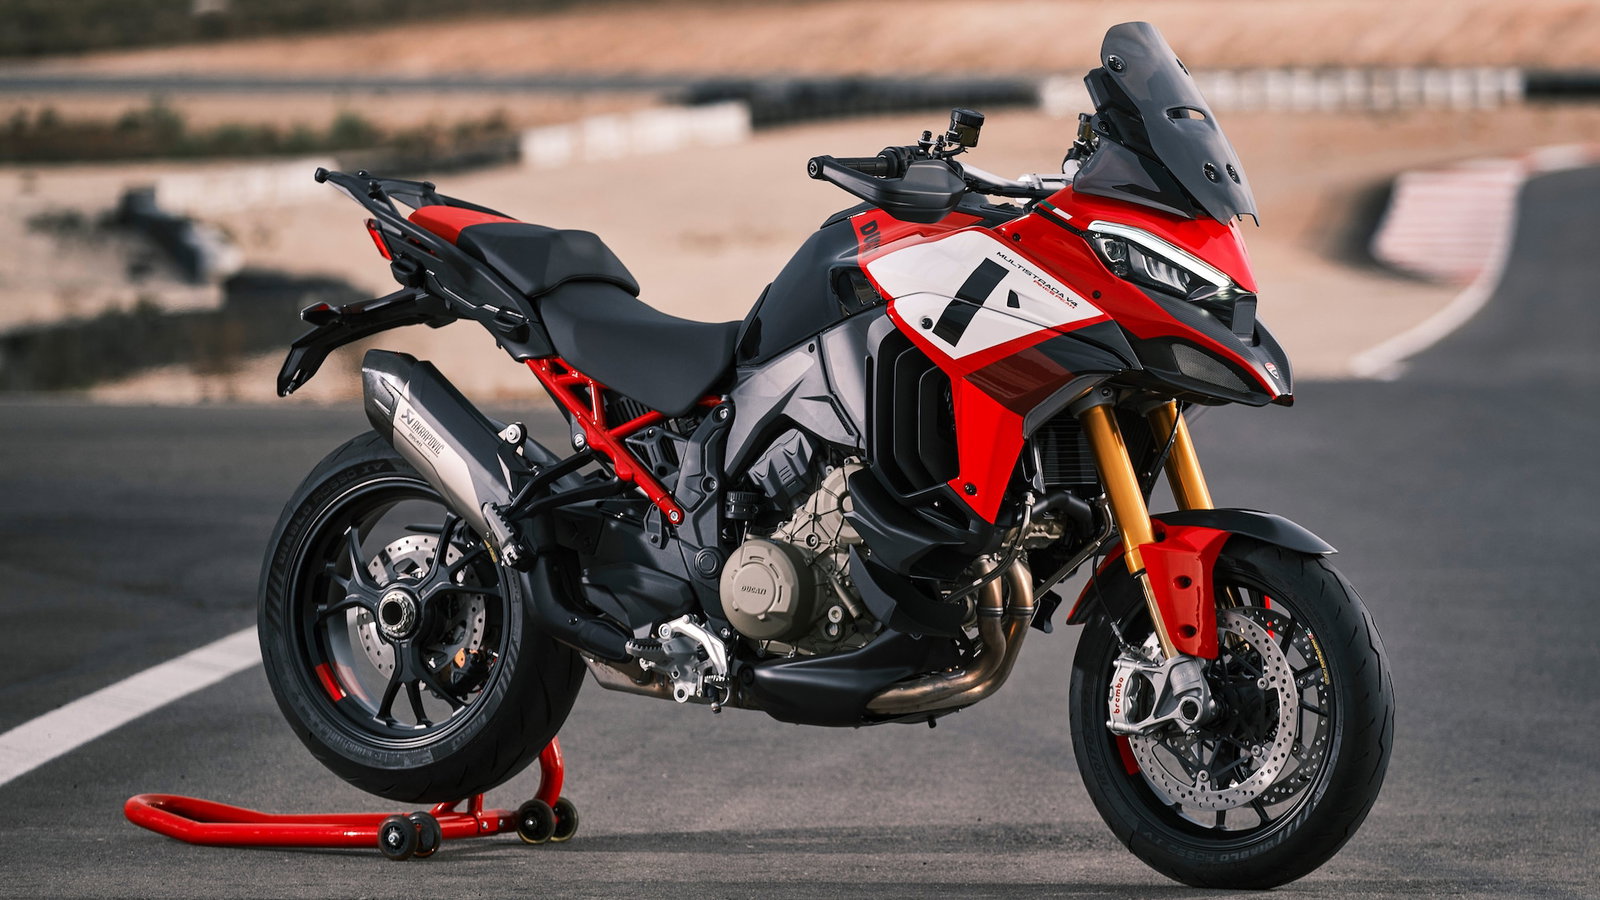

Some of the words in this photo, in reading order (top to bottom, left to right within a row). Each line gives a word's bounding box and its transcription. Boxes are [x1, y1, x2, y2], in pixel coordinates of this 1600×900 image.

[996, 251, 1065, 298] MULTISTRADA
[1066, 296, 1078, 307] V4
[741, 585, 767, 595] DUCATI
[1113, 677, 1124, 714] brembo
